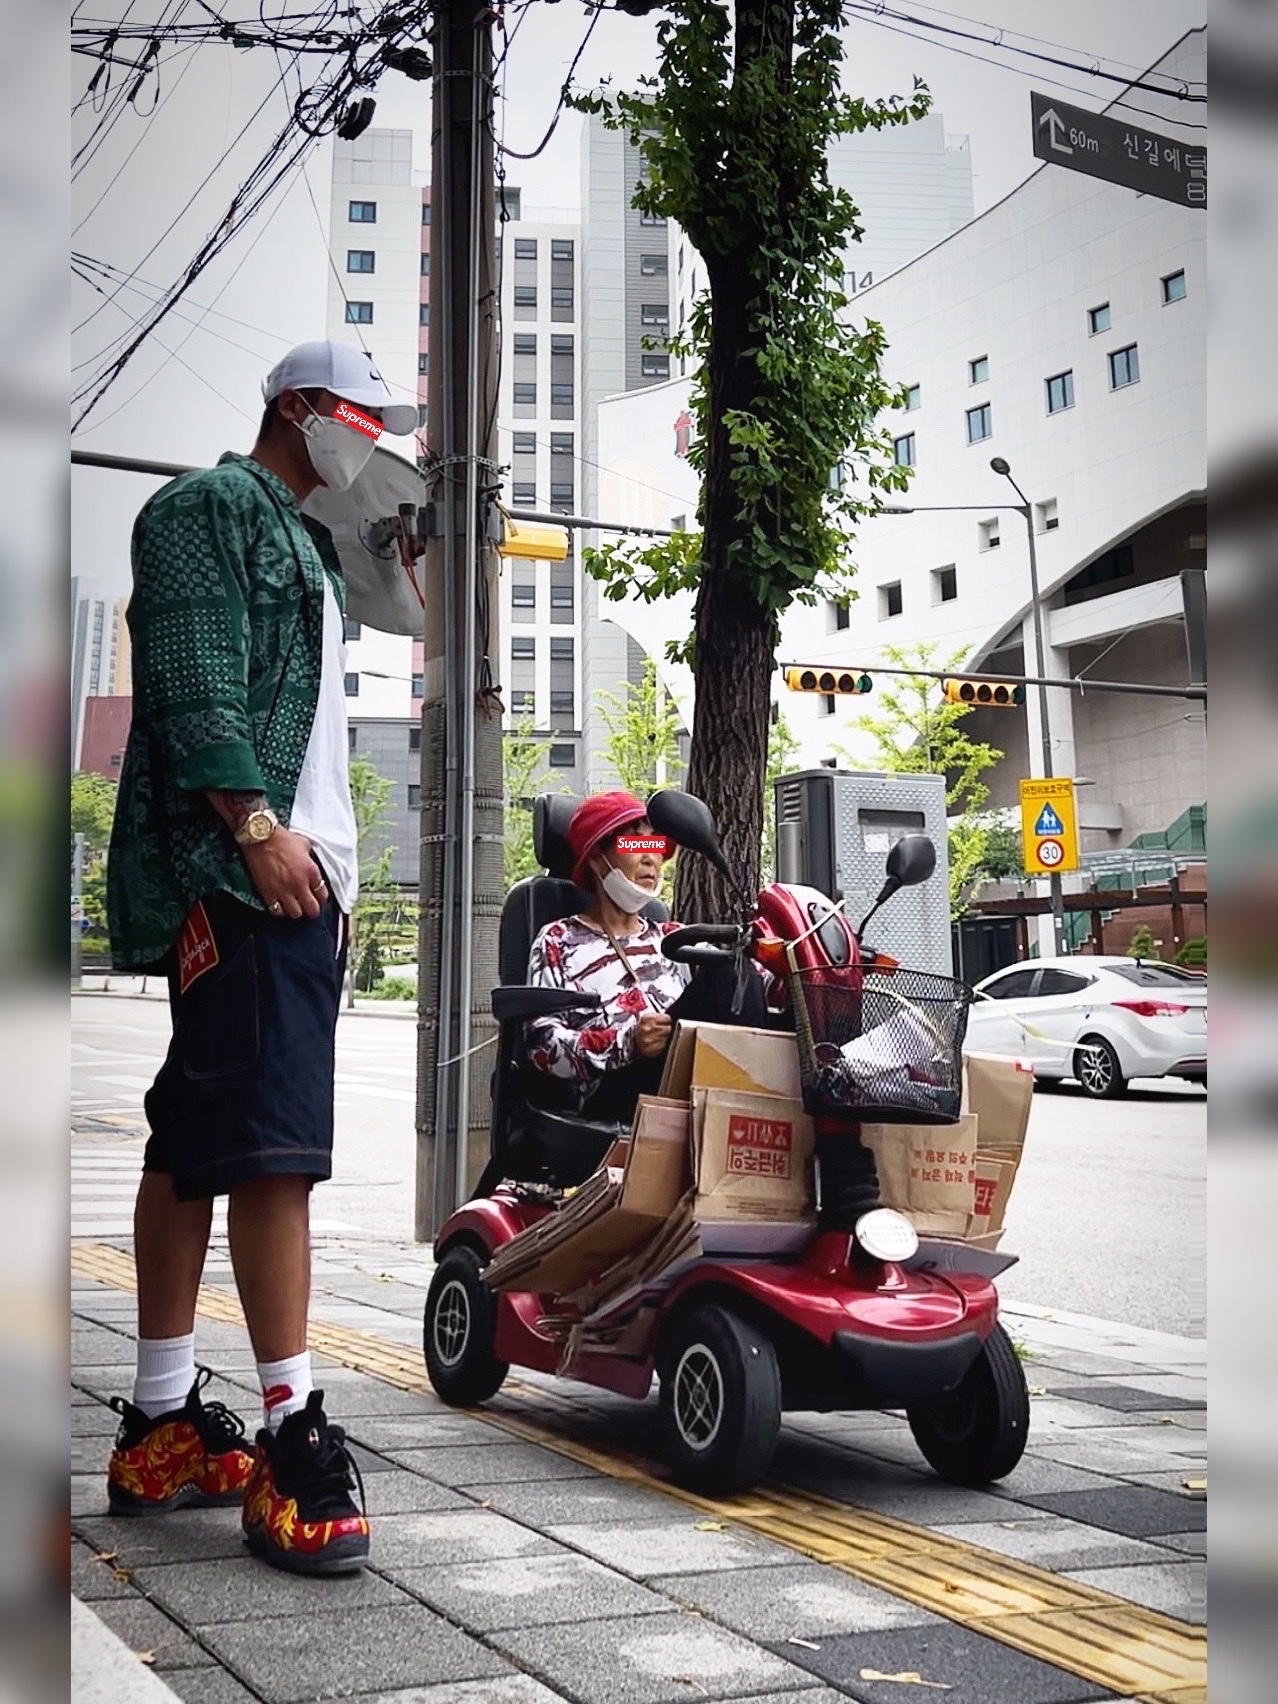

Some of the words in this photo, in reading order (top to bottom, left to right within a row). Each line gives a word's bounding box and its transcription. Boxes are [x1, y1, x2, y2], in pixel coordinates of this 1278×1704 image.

[1069, 127, 1099, 153] 60m
[1042, 846, 1058, 860] 30
[729, 1148, 786, 1175] 취급주의
[948, 1151, 967, 1165] 주의
